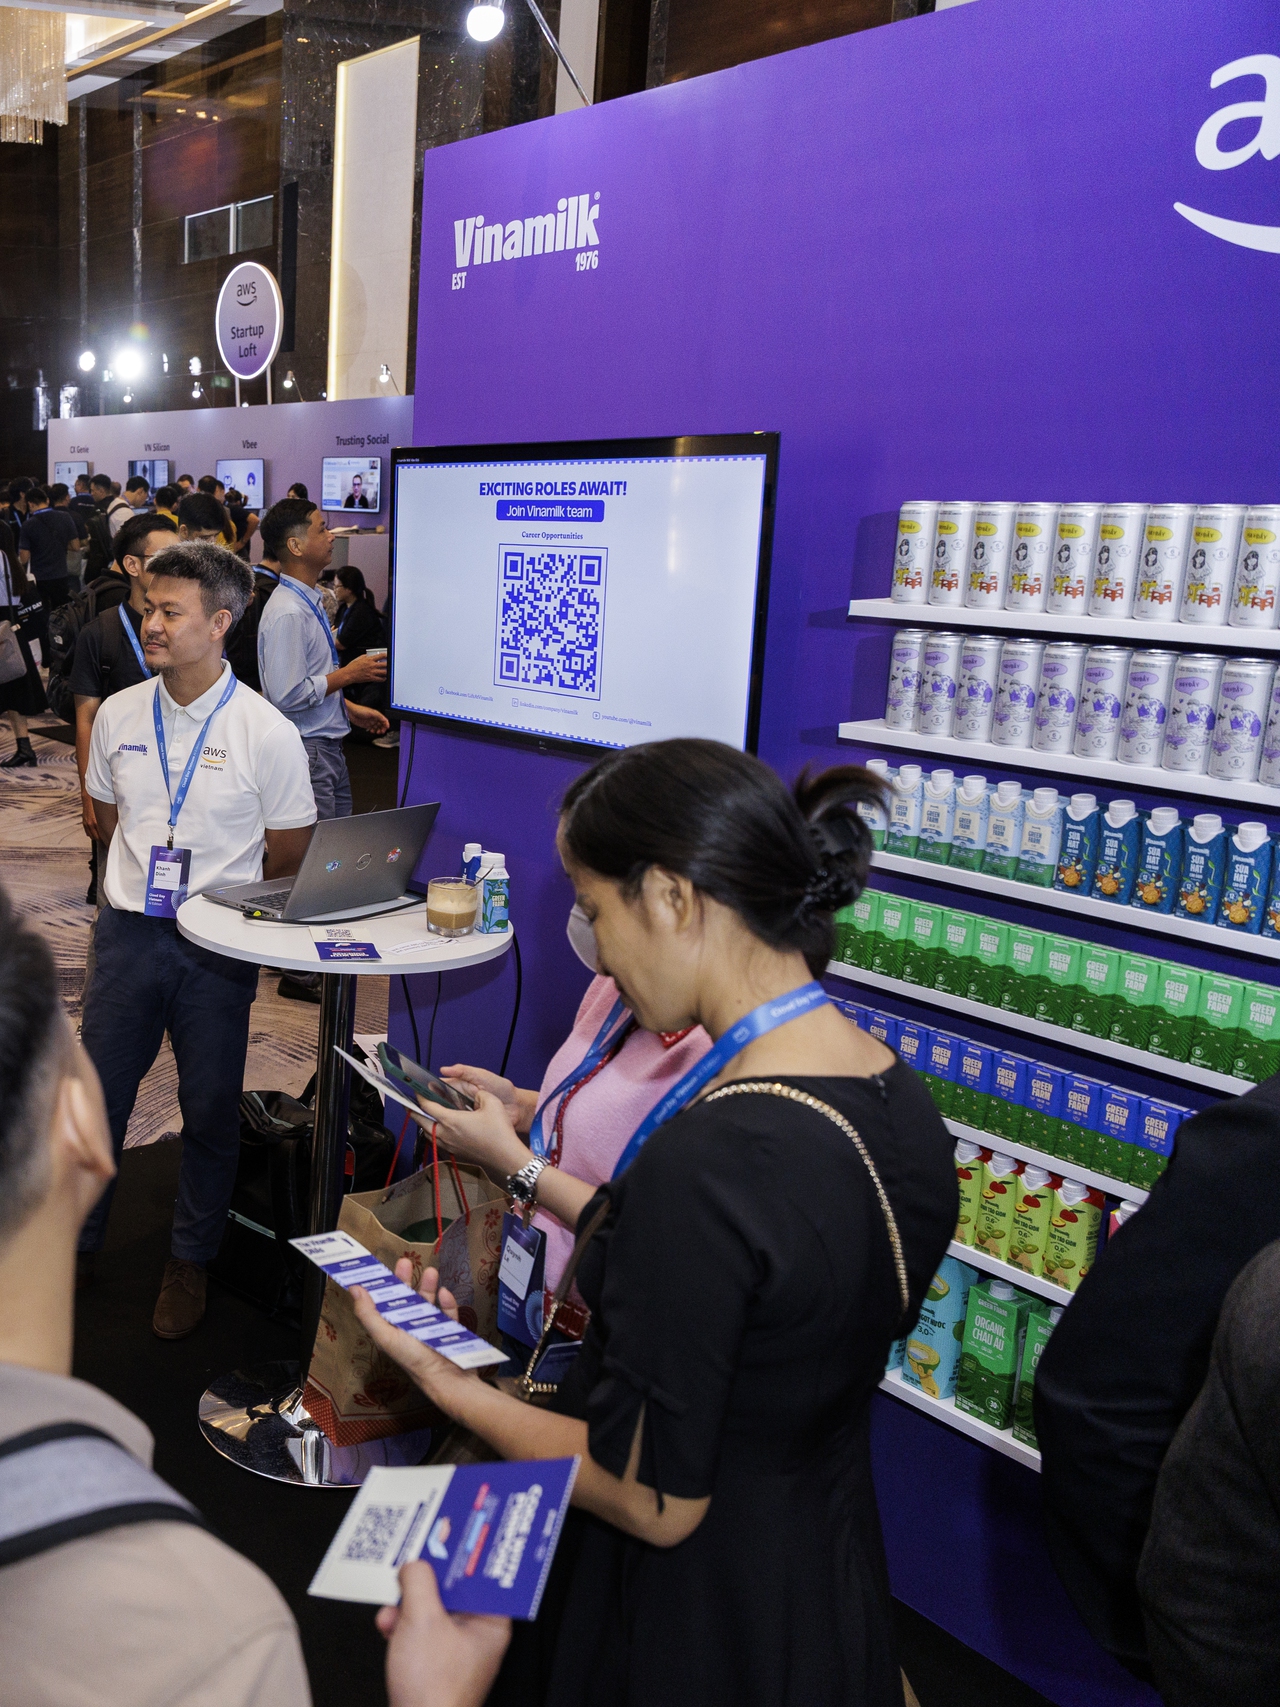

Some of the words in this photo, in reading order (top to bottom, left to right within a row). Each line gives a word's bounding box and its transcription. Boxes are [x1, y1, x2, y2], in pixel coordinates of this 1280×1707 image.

[454, 193, 600, 268] Vinamilk
[575, 250, 599, 271] 1976
[451, 272, 467, 290] EST
[236, 282, 257, 297] aws
[231, 323, 264, 341] Startup
[238, 344, 257, 359] Loft
[242, 440, 258, 449] Vbee
[335, 434, 365, 448] Trusting
[367, 433, 390, 446] Social
[77, 445, 89, 454] Genie
[144, 444, 152, 452] VN
[153, 443, 170, 452] Silicon
[479, 482, 533, 496] EXCITING
[535, 481, 576, 496] ROLES
[578, 481, 628, 496] AWAIT!
[506, 505, 525, 517] Join
[526, 505, 565, 517] Vinamilk
[567, 506, 593, 518] team
[541, 532, 584, 540] Opportunities
[203, 746, 227, 758] aws
[200, 764, 224, 772] vietnam
[854, 901, 871, 912] GREEN
[854, 909, 869, 920] FARM
[884, 909, 902, 920] GREEN
[884, 917, 900, 928] FARM
[914, 917, 933, 928] GREEN
[914, 925, 931, 936] FARM
[947, 924, 967, 936] GREEN
[946, 932, 965, 944] FARM
[980, 933, 999, 945] GREEN
[980, 941, 998, 953] FARM
[1014, 942, 1034, 954] GREEN
[1013, 950, 1032, 963] FARM
[1049, 951, 1071, 964] GREEN
[1049, 960, 1069, 973] FARM
[1086, 960, 1109, 973] GREEN
[1086, 969, 1106, 982] FARM
[1125, 970, 1148, 984] GREEN
[1124, 979, 1146, 992] FARM
[1165, 980, 1189, 994] GREEN
[1164, 990, 1186, 1003] FARM
[1207, 991, 1232, 1006] GREEN
[1207, 1001, 1229, 1015] FARM
[1250, 1002, 1276, 1017] GREEN
[1250, 1012, 1273, 1026] FARM
[870, 1025, 887, 1037] GREEN
[901, 1035, 919, 1048] GREEN
[900, 1043, 917, 1056] FARM
[932, 1045, 952, 1058] GREEN
[932, 1053, 949, 1066] FARM
[963, 1056, 982, 1069] GREEN
[963, 1065, 980, 1077] FARM
[997, 1067, 1017, 1080] GREEN
[996, 1076, 1015, 1089] FARM
[1031, 1079, 1053, 1094] GREEN
[1031, 1088, 1051, 1101] FARM
[1068, 1091, 1090, 1106] GREEN
[1068, 1100, 1088, 1113] FARM
[1106, 1103, 1129, 1118] GREEN
[1106, 1112, 1126, 1127] FARM
[1145, 1116, 1168, 1132] GREEN
[1145, 1126, 1166, 1140] FARM
[978, 1298, 994, 1310] GREEN
[993, 1306, 1008, 1317] FARM
[975, 1315, 1006, 1338] ORGANIC
[1037, 1326, 1053, 1337] GREE
